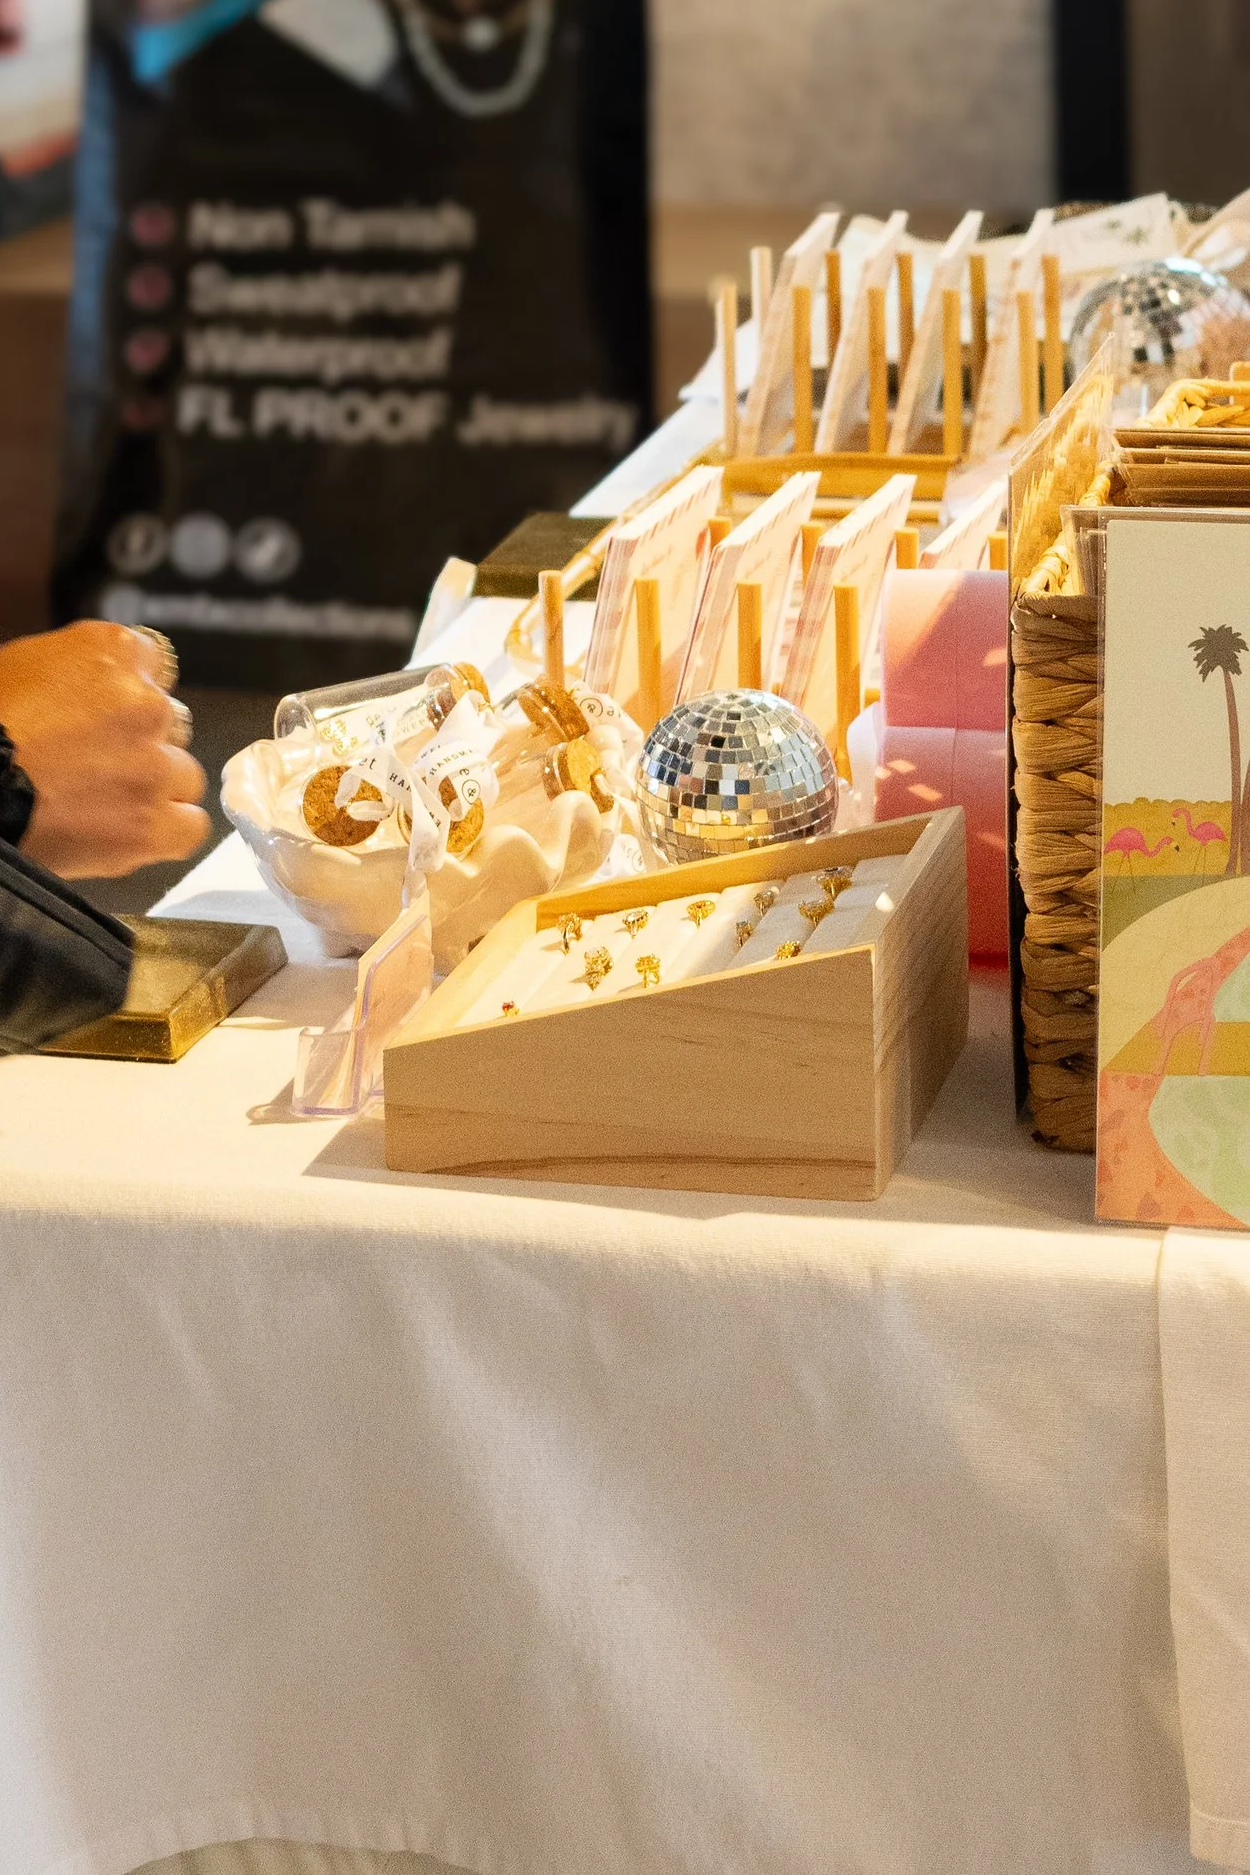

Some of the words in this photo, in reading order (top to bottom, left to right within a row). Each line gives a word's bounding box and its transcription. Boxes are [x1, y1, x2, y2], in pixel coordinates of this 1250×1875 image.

[184, 327, 451, 382] Waterproof
[178, 388, 242, 438] FL
[254, 388, 444, 444] PROOF
